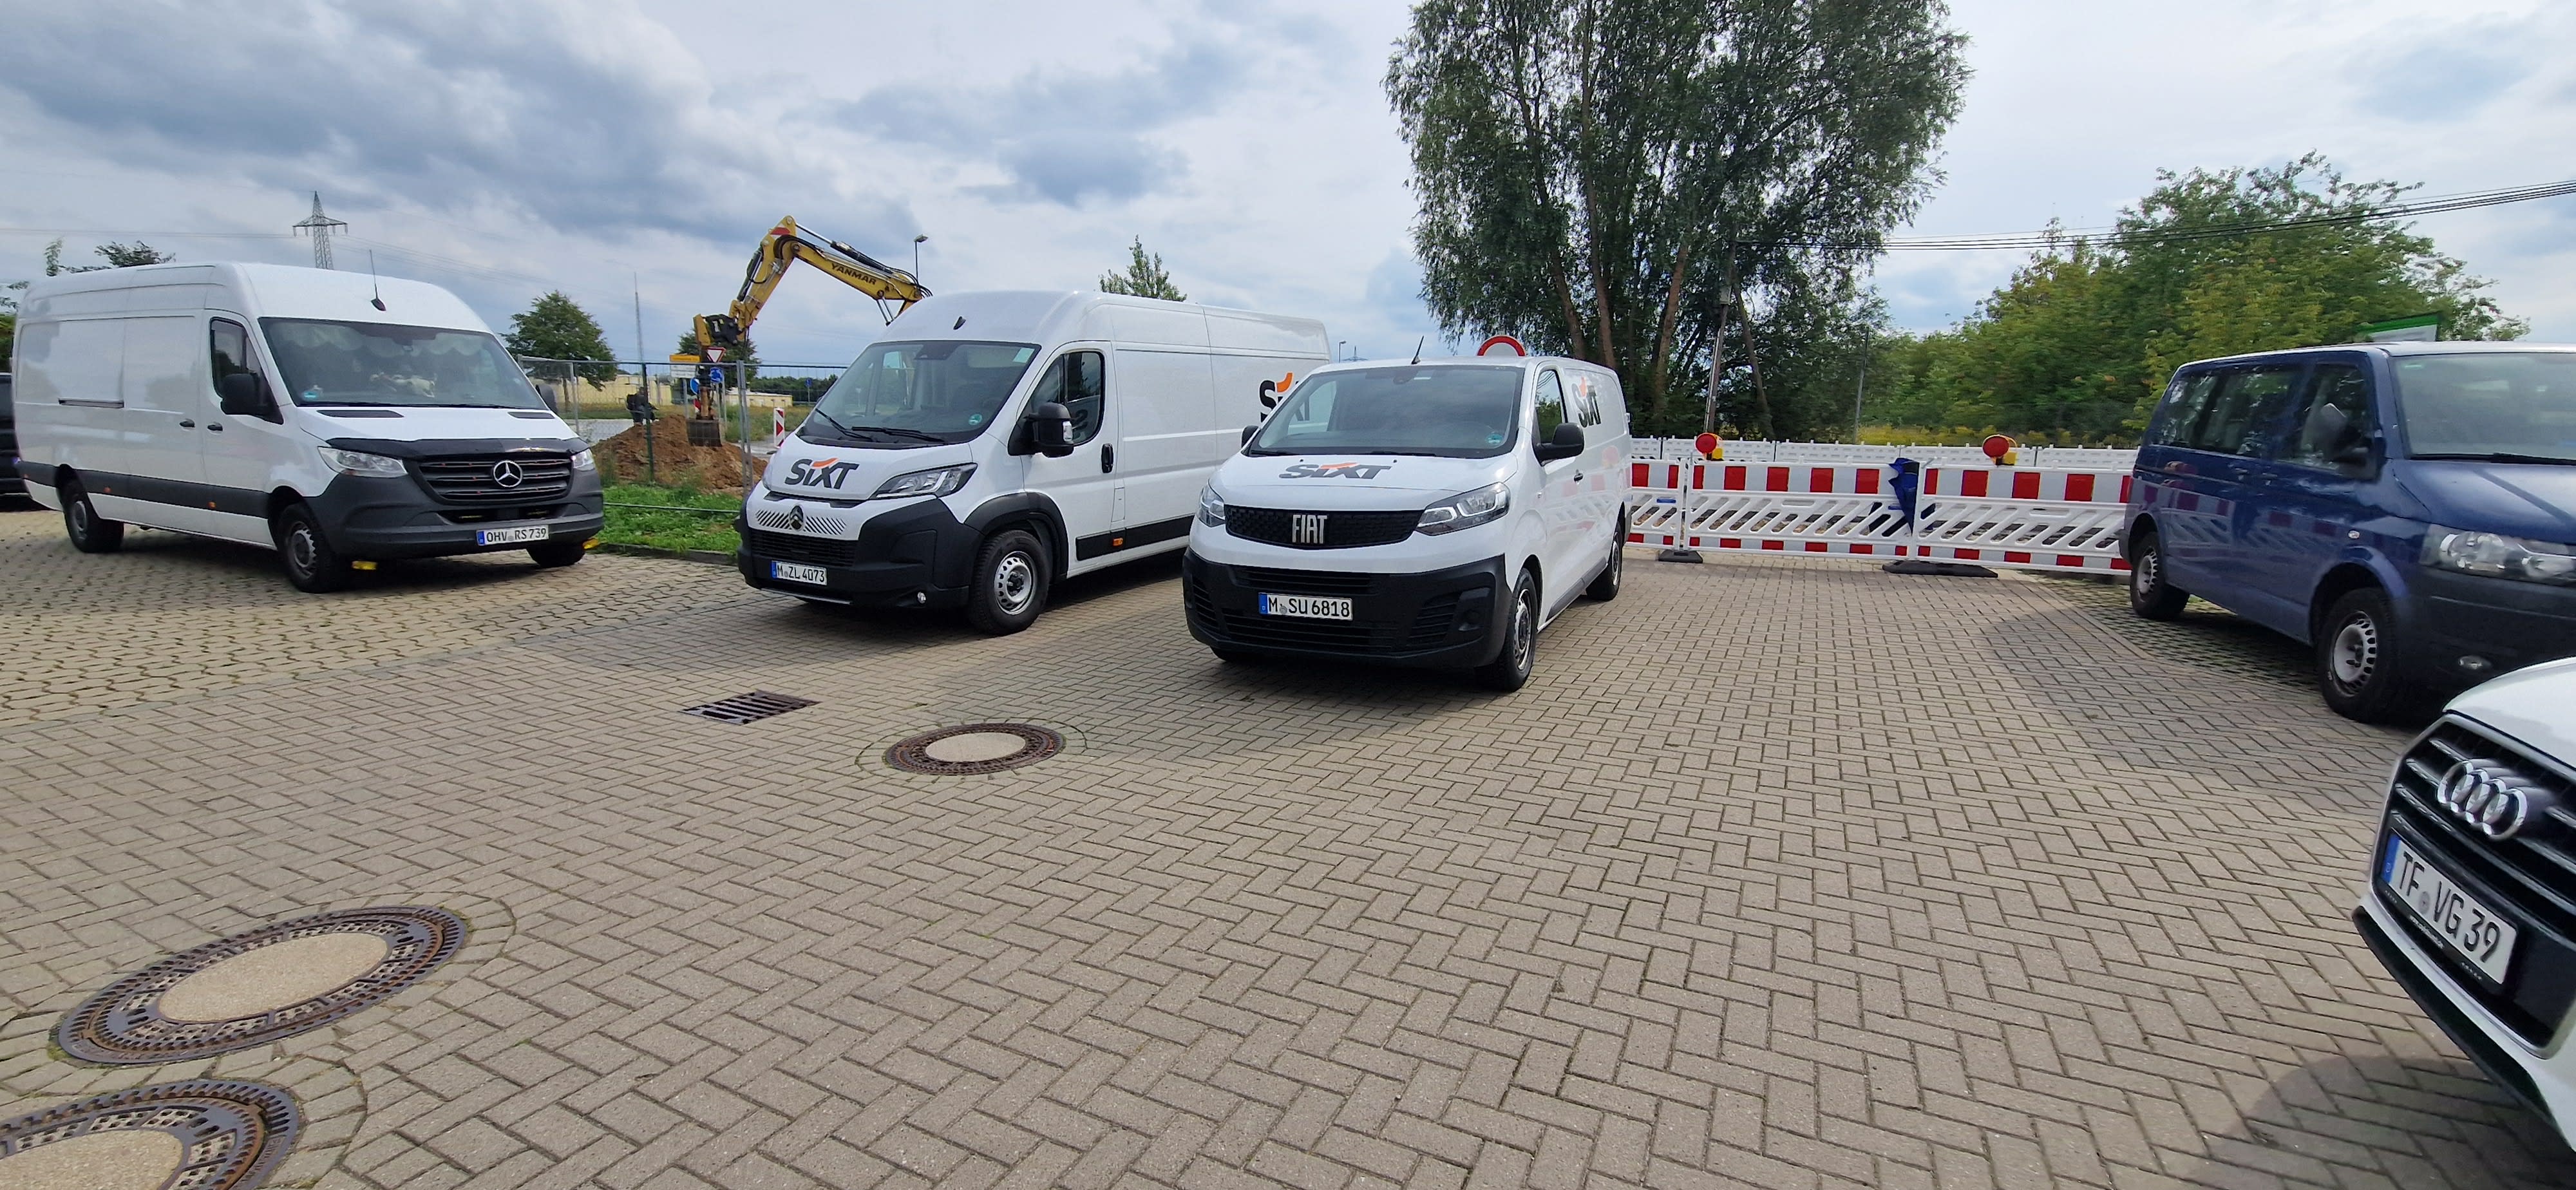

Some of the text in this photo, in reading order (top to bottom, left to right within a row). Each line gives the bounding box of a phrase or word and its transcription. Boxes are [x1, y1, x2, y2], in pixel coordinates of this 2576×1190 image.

[831, 263, 876, 285] YANMAR
[1571, 377, 1602, 428] SIXT
[784, 457, 860, 489] SIXT
[1279, 462, 1392, 480] SIXT
[486, 531, 507, 542] OHV
[1292, 515, 1327, 544] FIAT
[777, 565, 824, 582] M ZL 4073
[1268, 597, 1278, 612] M
[1289, 598, 1308, 614] SU
[1312, 600, 1350, 617] 6818
[2400, 850, 2425, 896] TF
[2433, 881, 2465, 940] VG
[2464, 908, 2500, 963] 39
